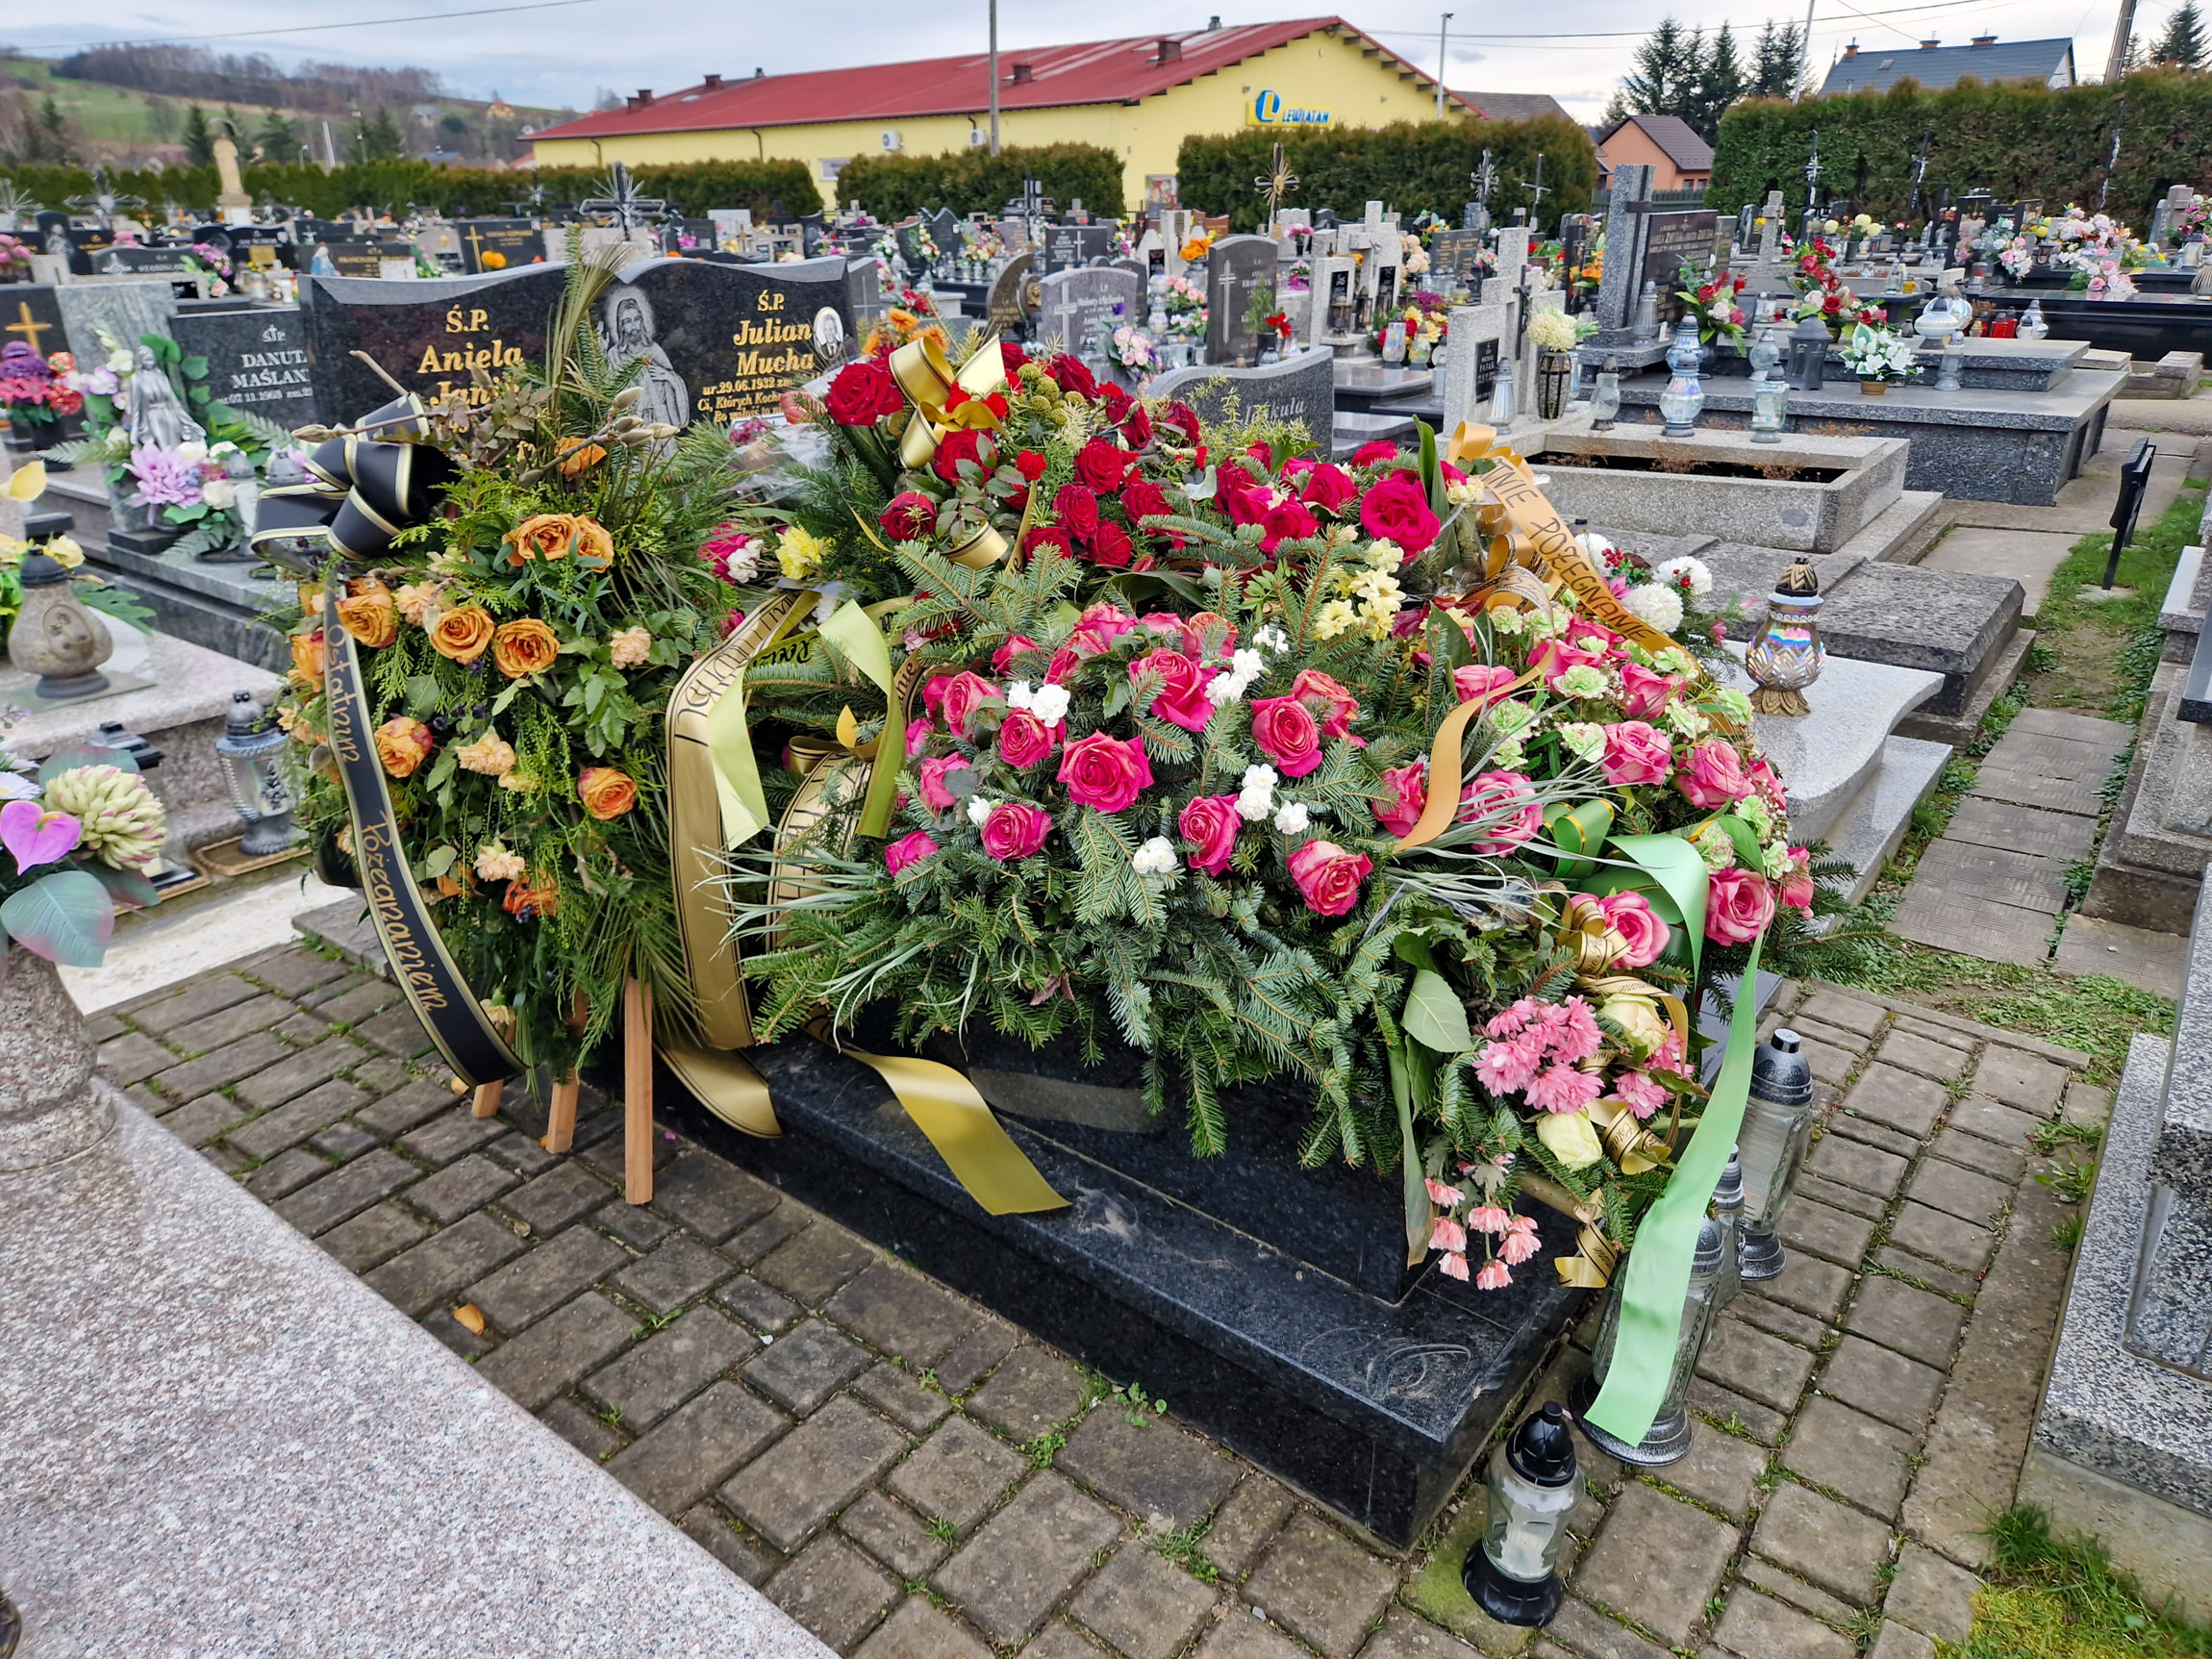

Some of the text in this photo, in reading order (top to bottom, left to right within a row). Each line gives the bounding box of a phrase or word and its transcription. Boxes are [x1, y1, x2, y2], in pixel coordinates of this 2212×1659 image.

[1282, 108, 1329, 123] LEWIATAN
[758, 289, 785, 312] Ś.P.
[445, 304, 490, 333] Ś.P.
[733, 318, 813, 345] Julian
[240, 349, 308, 367] DANUT
[416, 339, 525, 374] Aniela
[736, 348, 815, 376] Mucha
[697, 398, 713, 412] Ci,
